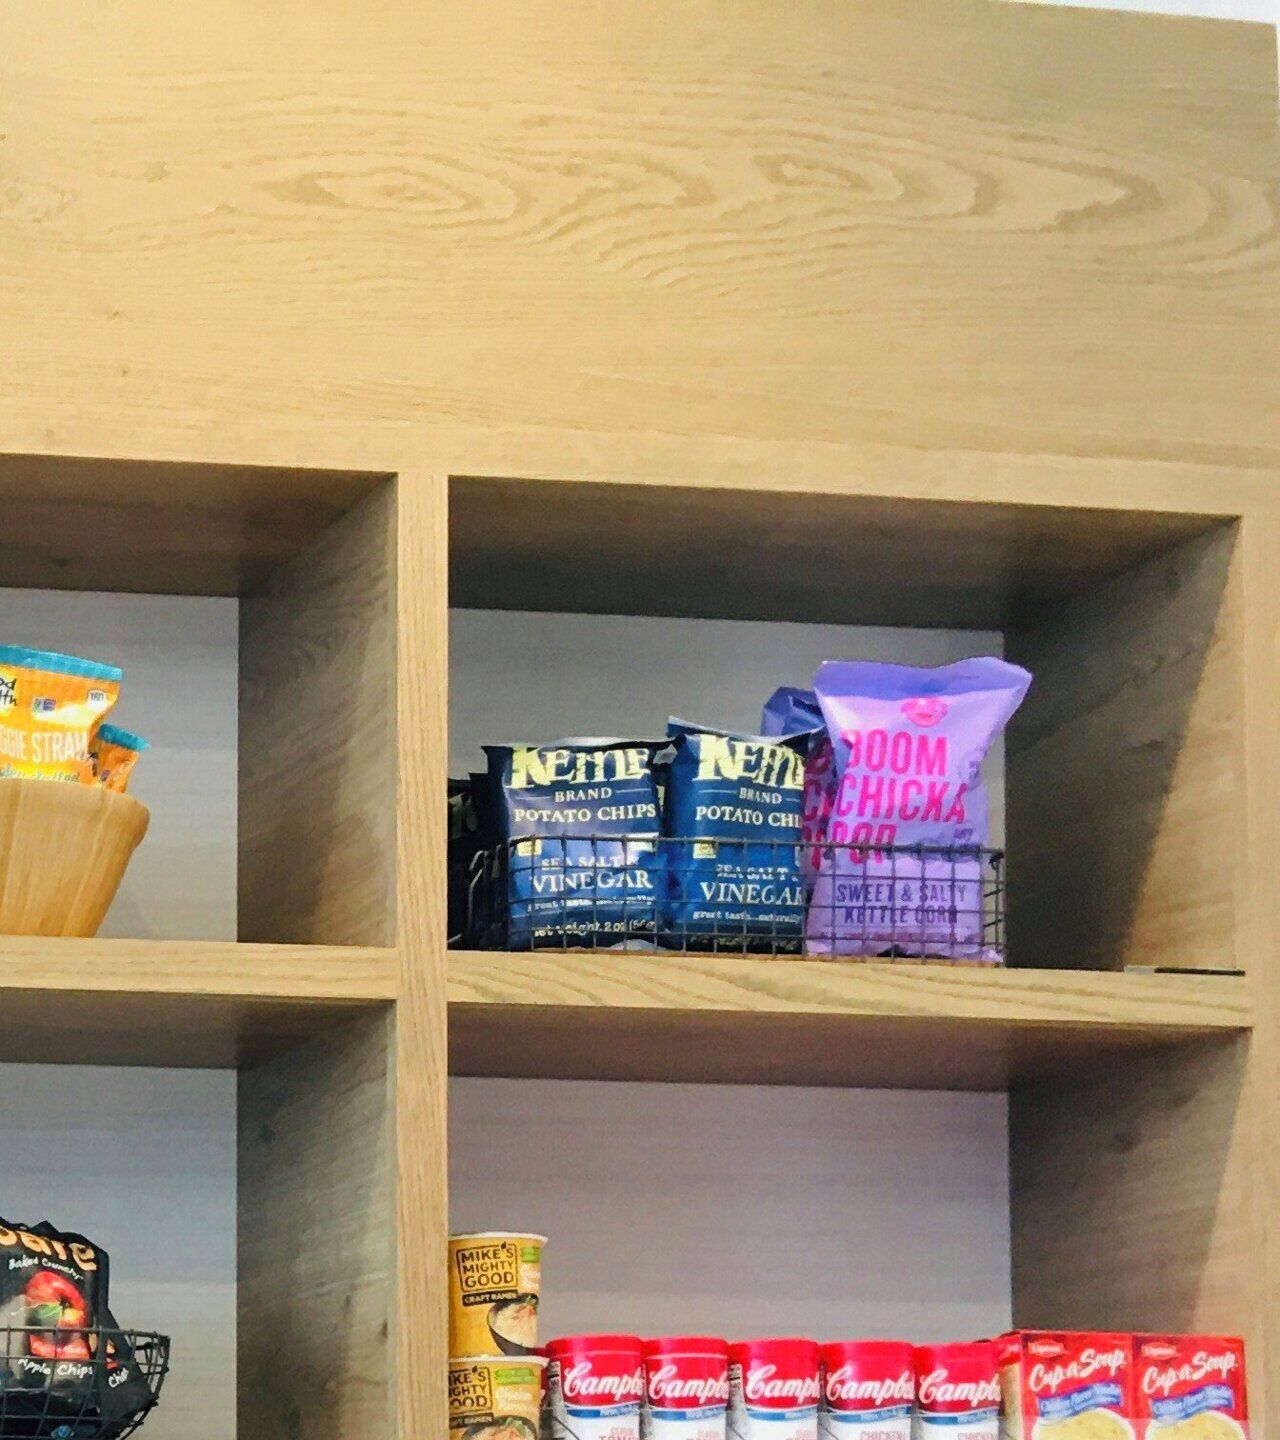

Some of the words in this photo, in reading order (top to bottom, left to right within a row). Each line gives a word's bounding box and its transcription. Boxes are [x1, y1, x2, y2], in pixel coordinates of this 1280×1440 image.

[554, 787, 612, 803] BRAND
[739, 787, 782, 804] BRAND
[836, 774, 968, 824] CHICKA
[513, 808, 592, 823] POTATO
[597, 804, 656, 821] CHIPS
[696, 805, 762, 825] POTATO
[532, 870, 653, 893] VINEGAR
[461, 1242, 514, 1263] MIKE'S
[462, 1261, 513, 1275] MIGHTY
[464, 1271, 514, 1288] GOOD
